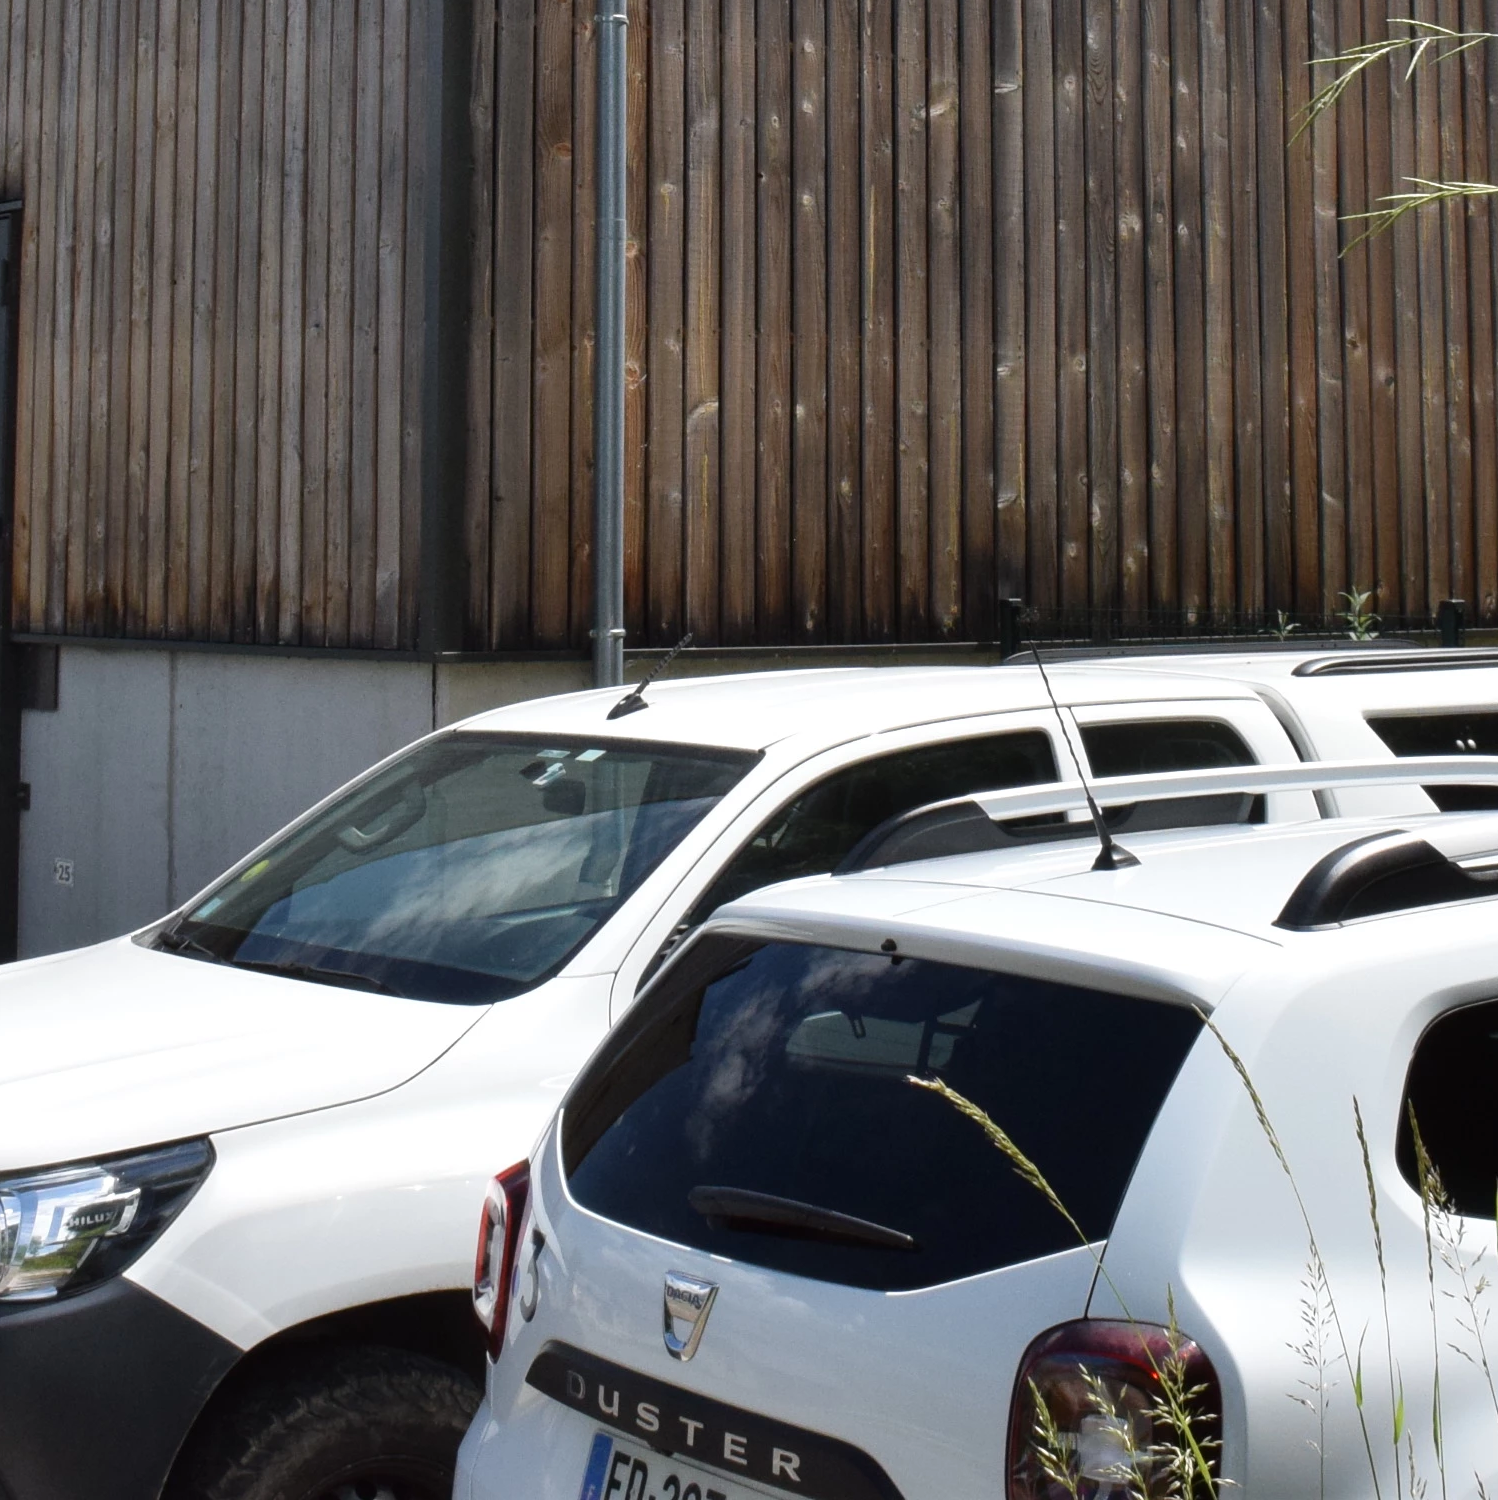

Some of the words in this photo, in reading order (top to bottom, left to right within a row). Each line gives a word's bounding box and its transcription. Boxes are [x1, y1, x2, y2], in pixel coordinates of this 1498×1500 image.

[67, 1211, 113, 1227] HILUX
[667, 1285, 702, 1310] DACIA
[565, 1370, 801, 1483] DUSTER
